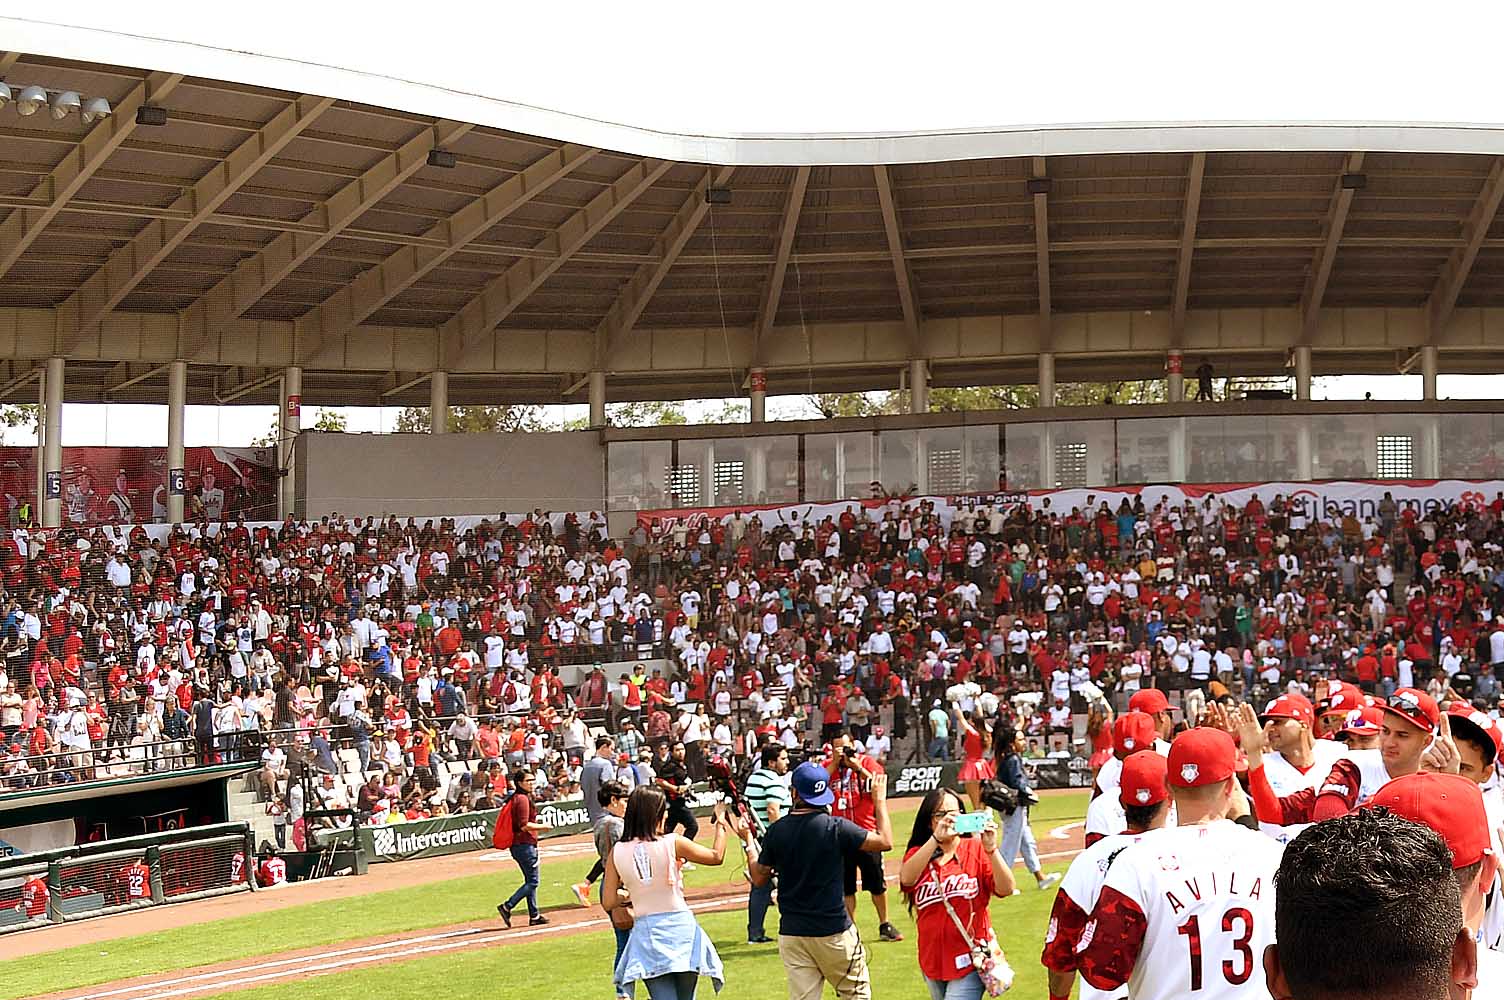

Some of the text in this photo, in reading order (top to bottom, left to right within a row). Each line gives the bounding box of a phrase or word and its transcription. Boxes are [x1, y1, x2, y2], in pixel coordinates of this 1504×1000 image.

[52, 480, 60, 493] 5
[175, 477, 183, 490] 6
[901, 766, 942, 780] SPORT
[910, 778, 941, 791] CITY
[397, 821, 486, 852] Interceramic
[1166, 872, 1261, 914] AVILA
[1178, 907, 1254, 991] 13
